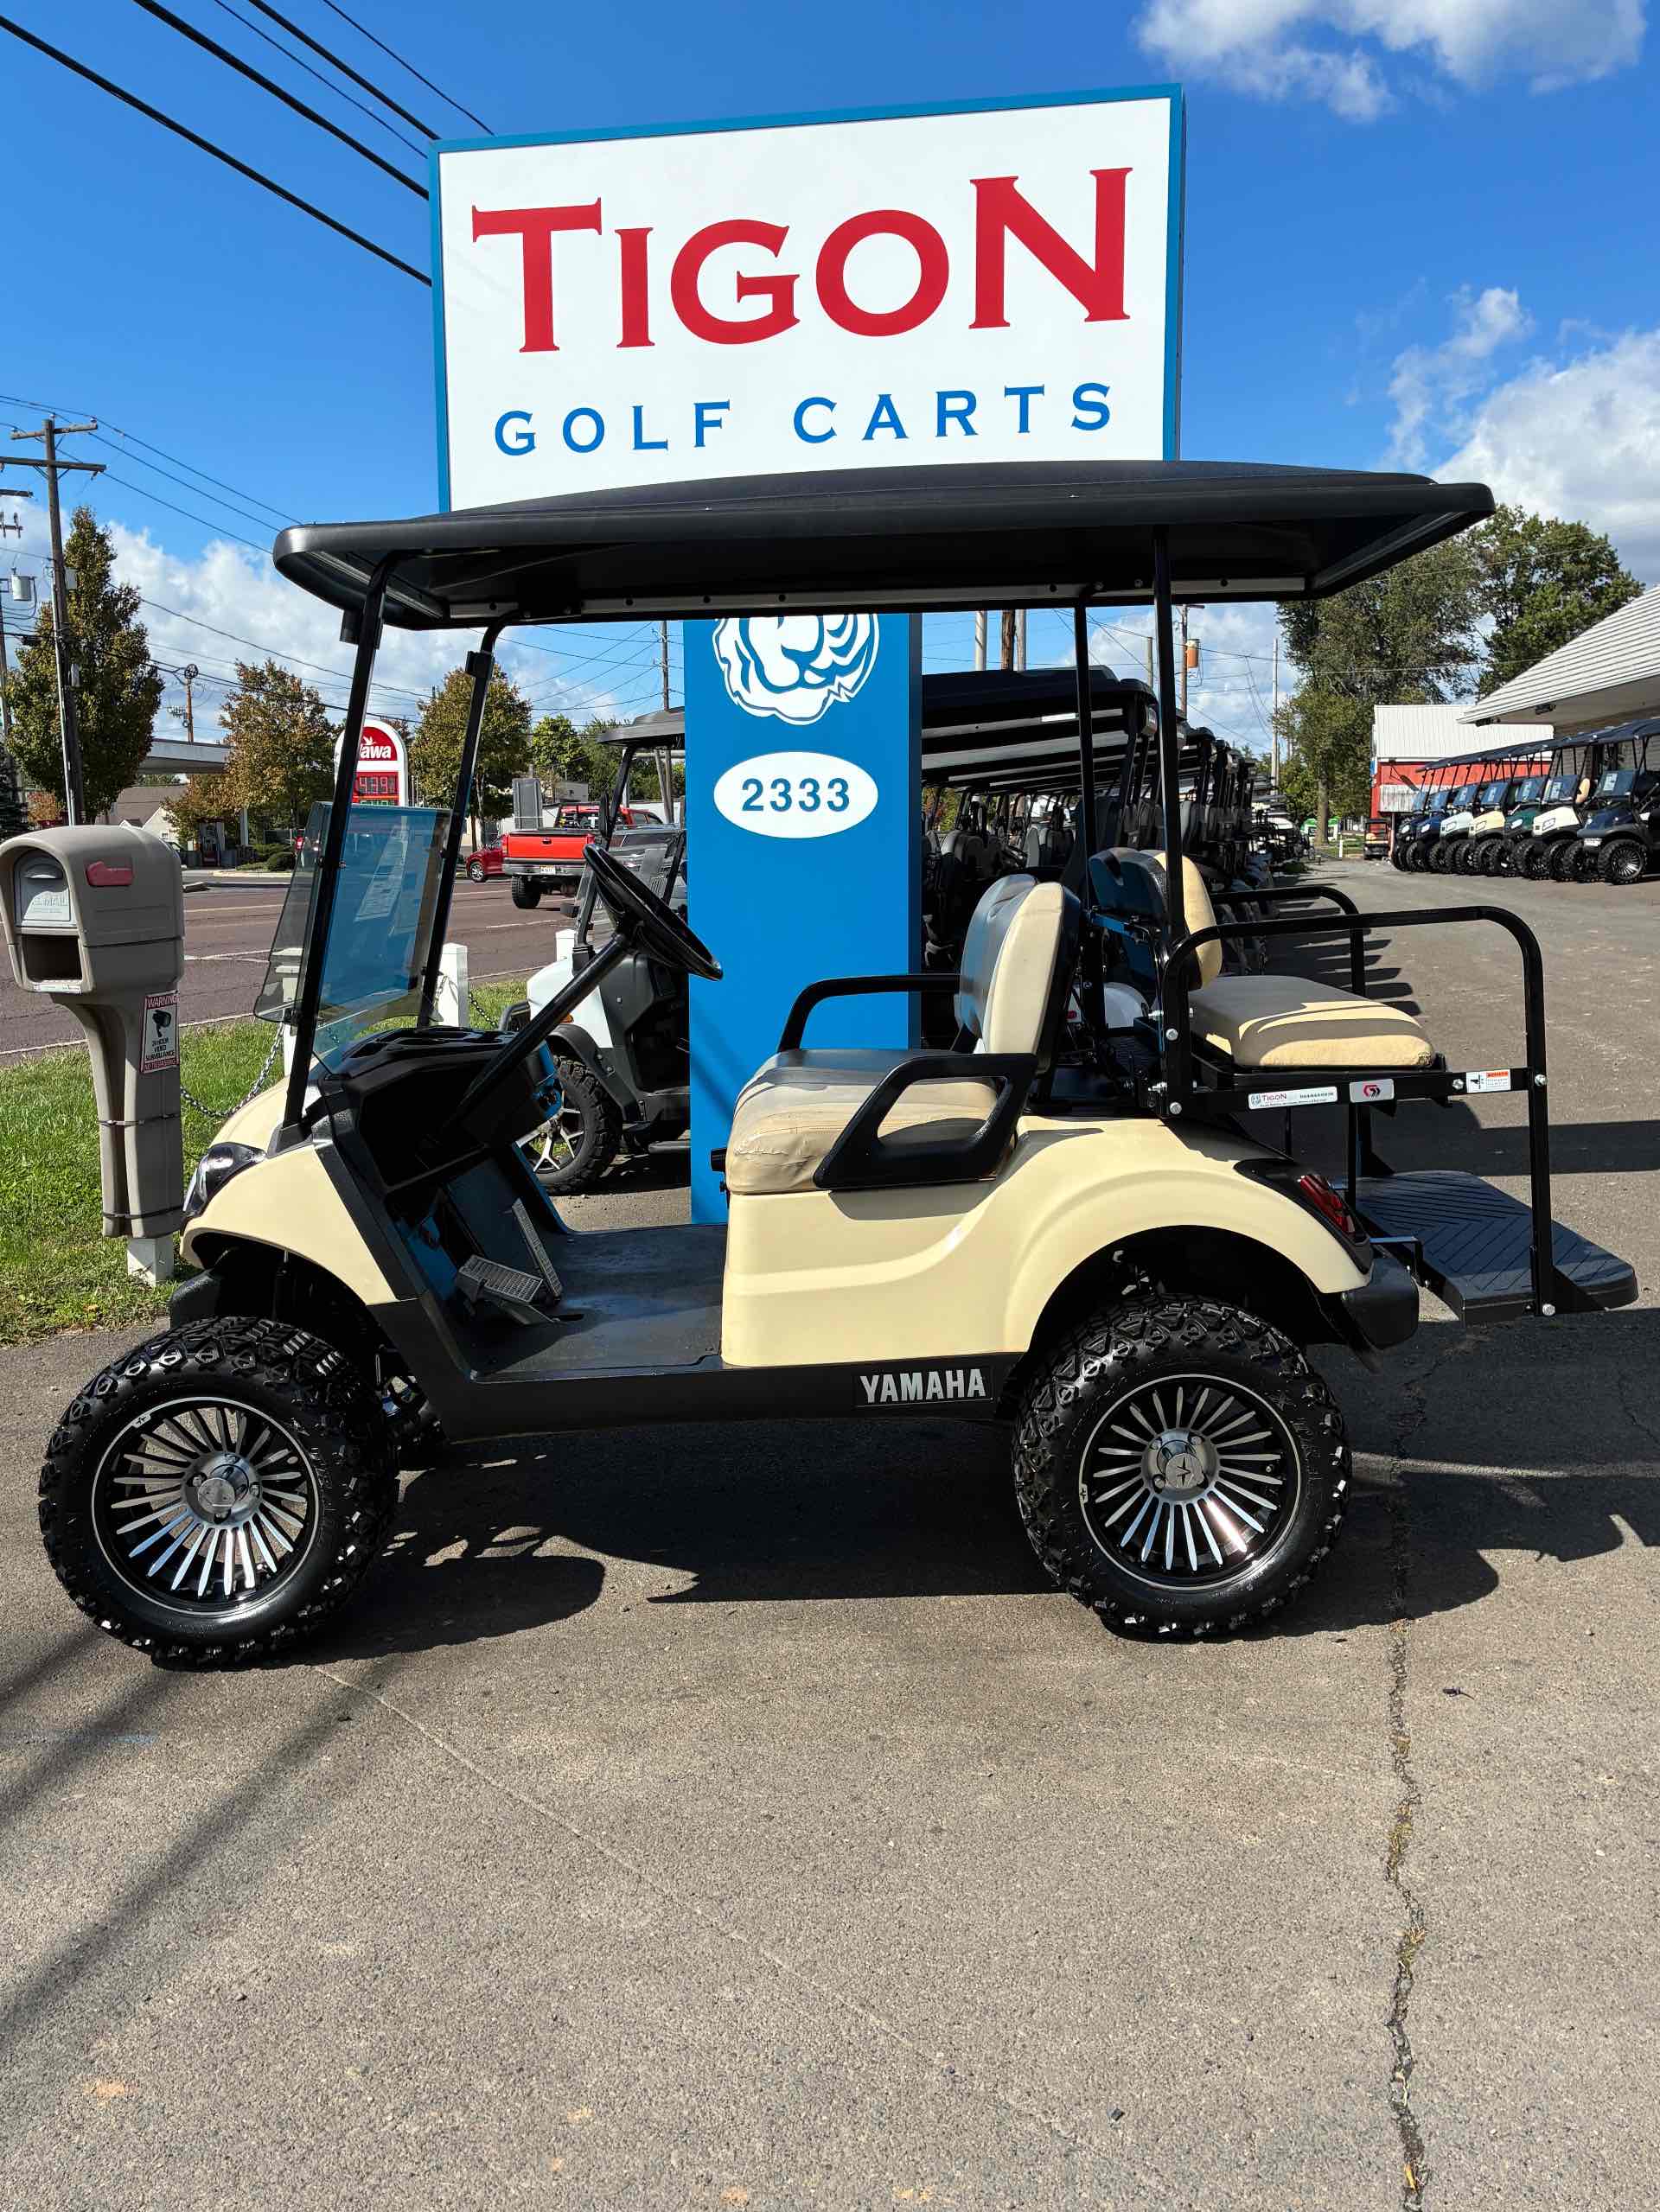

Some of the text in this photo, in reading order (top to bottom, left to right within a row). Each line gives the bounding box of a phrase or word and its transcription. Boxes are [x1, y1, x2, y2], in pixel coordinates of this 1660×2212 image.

[472, 167, 1133, 353] TIGON
[495, 383, 1110, 456] GOLF CARTS
[359, 743, 392, 759] awa
[743, 778, 849, 812] 2333
[147, 995, 180, 1008] WARNING
[860, 1369, 985, 1403] YAMAHA
